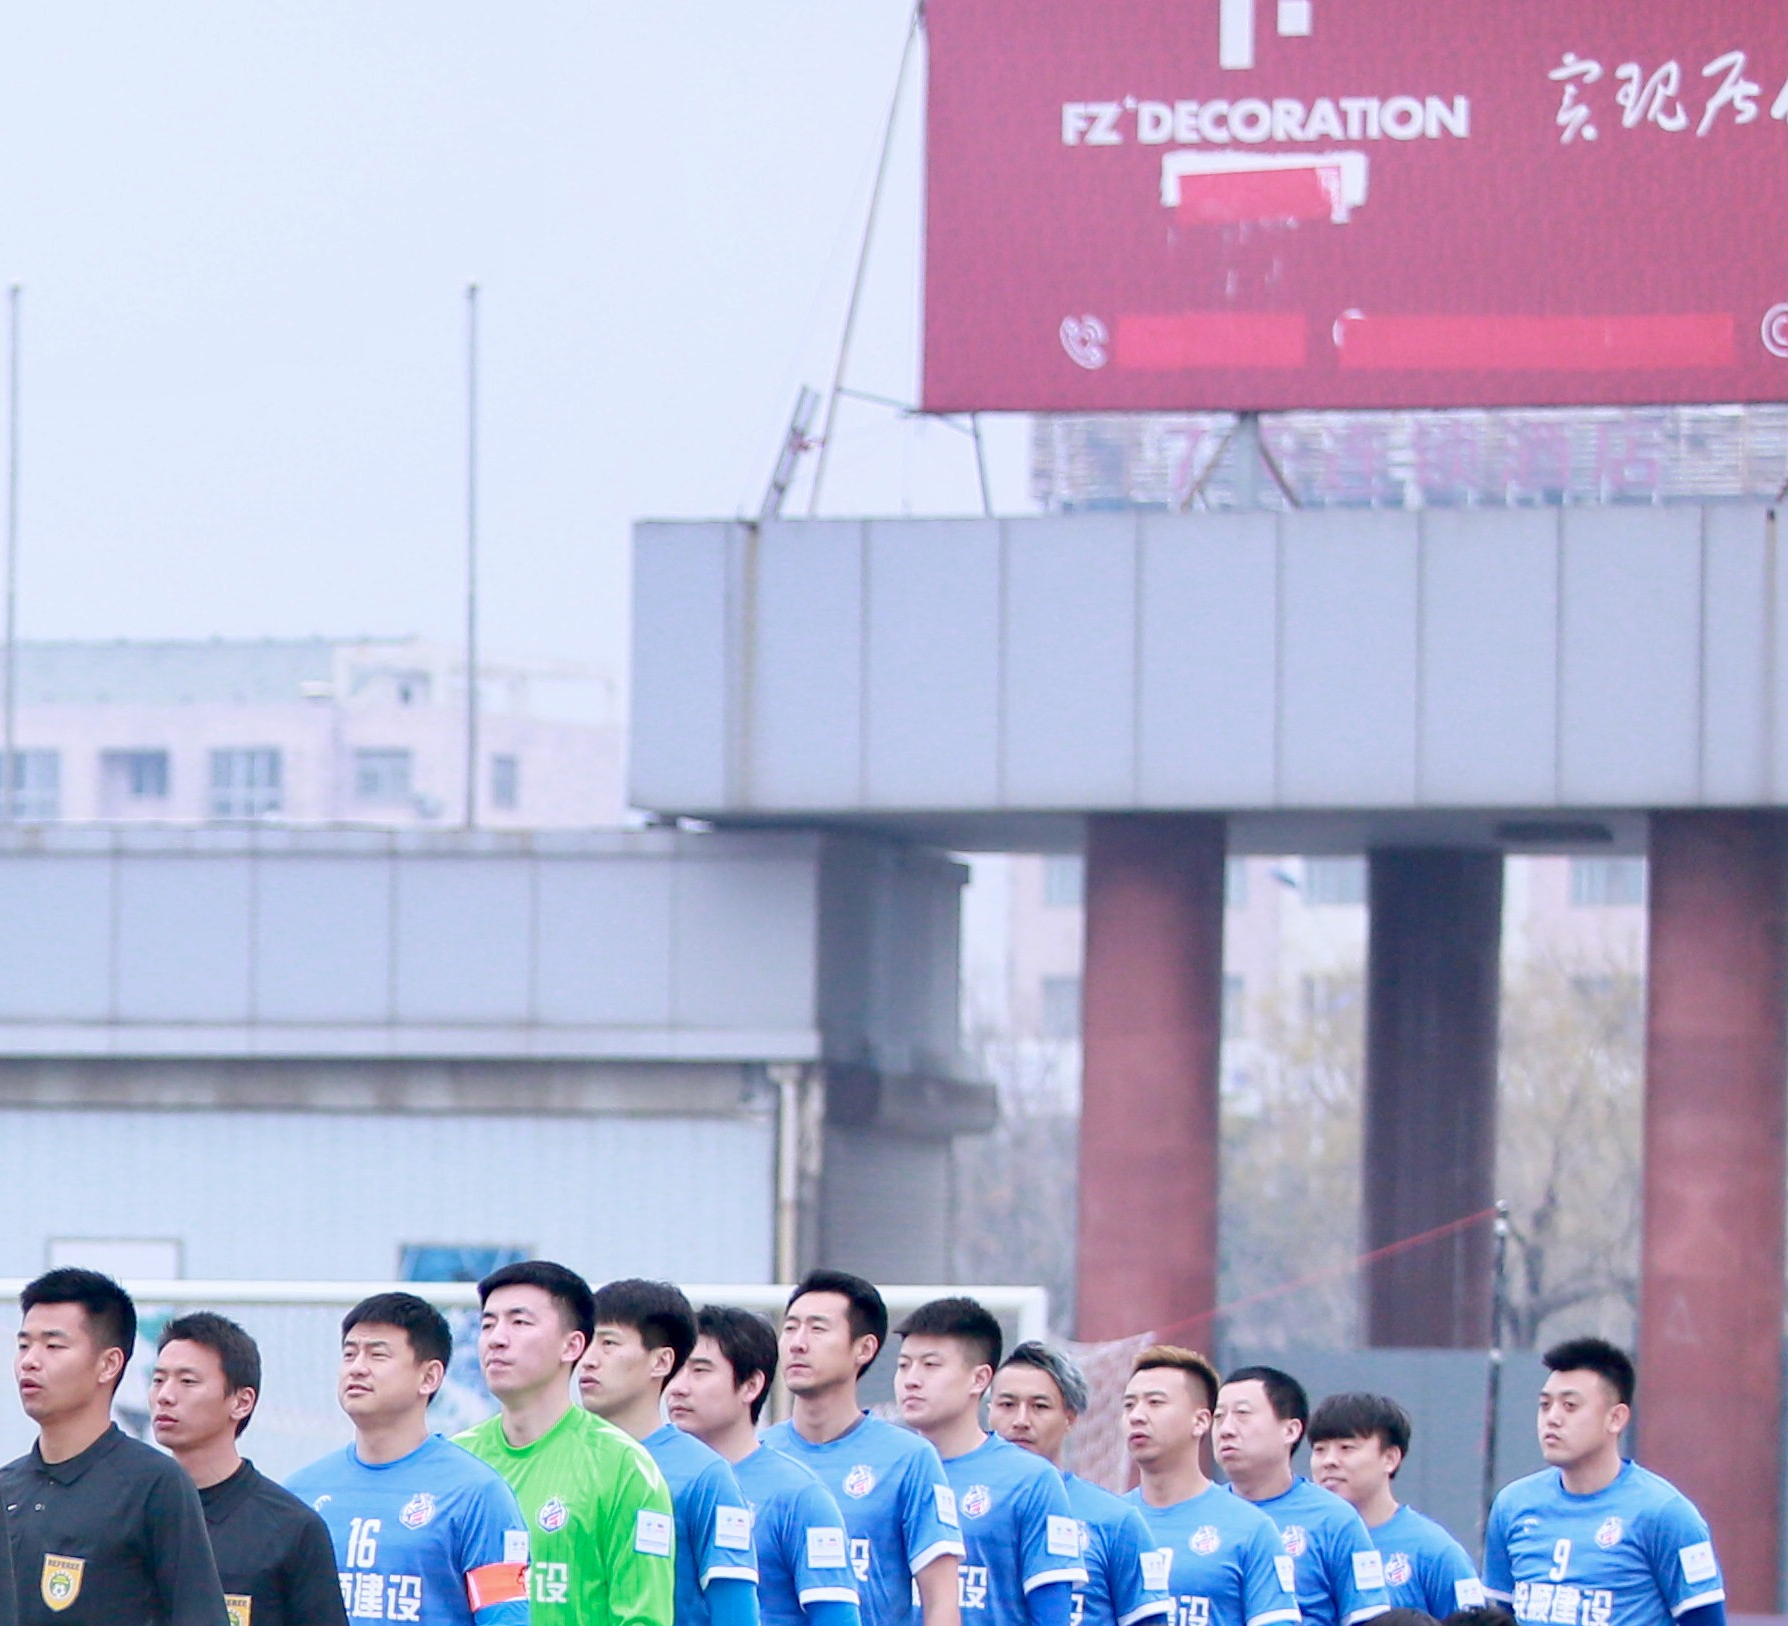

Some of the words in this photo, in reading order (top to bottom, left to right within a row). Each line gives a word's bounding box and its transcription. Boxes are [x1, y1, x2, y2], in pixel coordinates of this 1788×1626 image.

[1136, 95, 1470, 146] DECORATION
[346, 1517, 382, 1569] 16
[1548, 1538, 1572, 1582] 9
